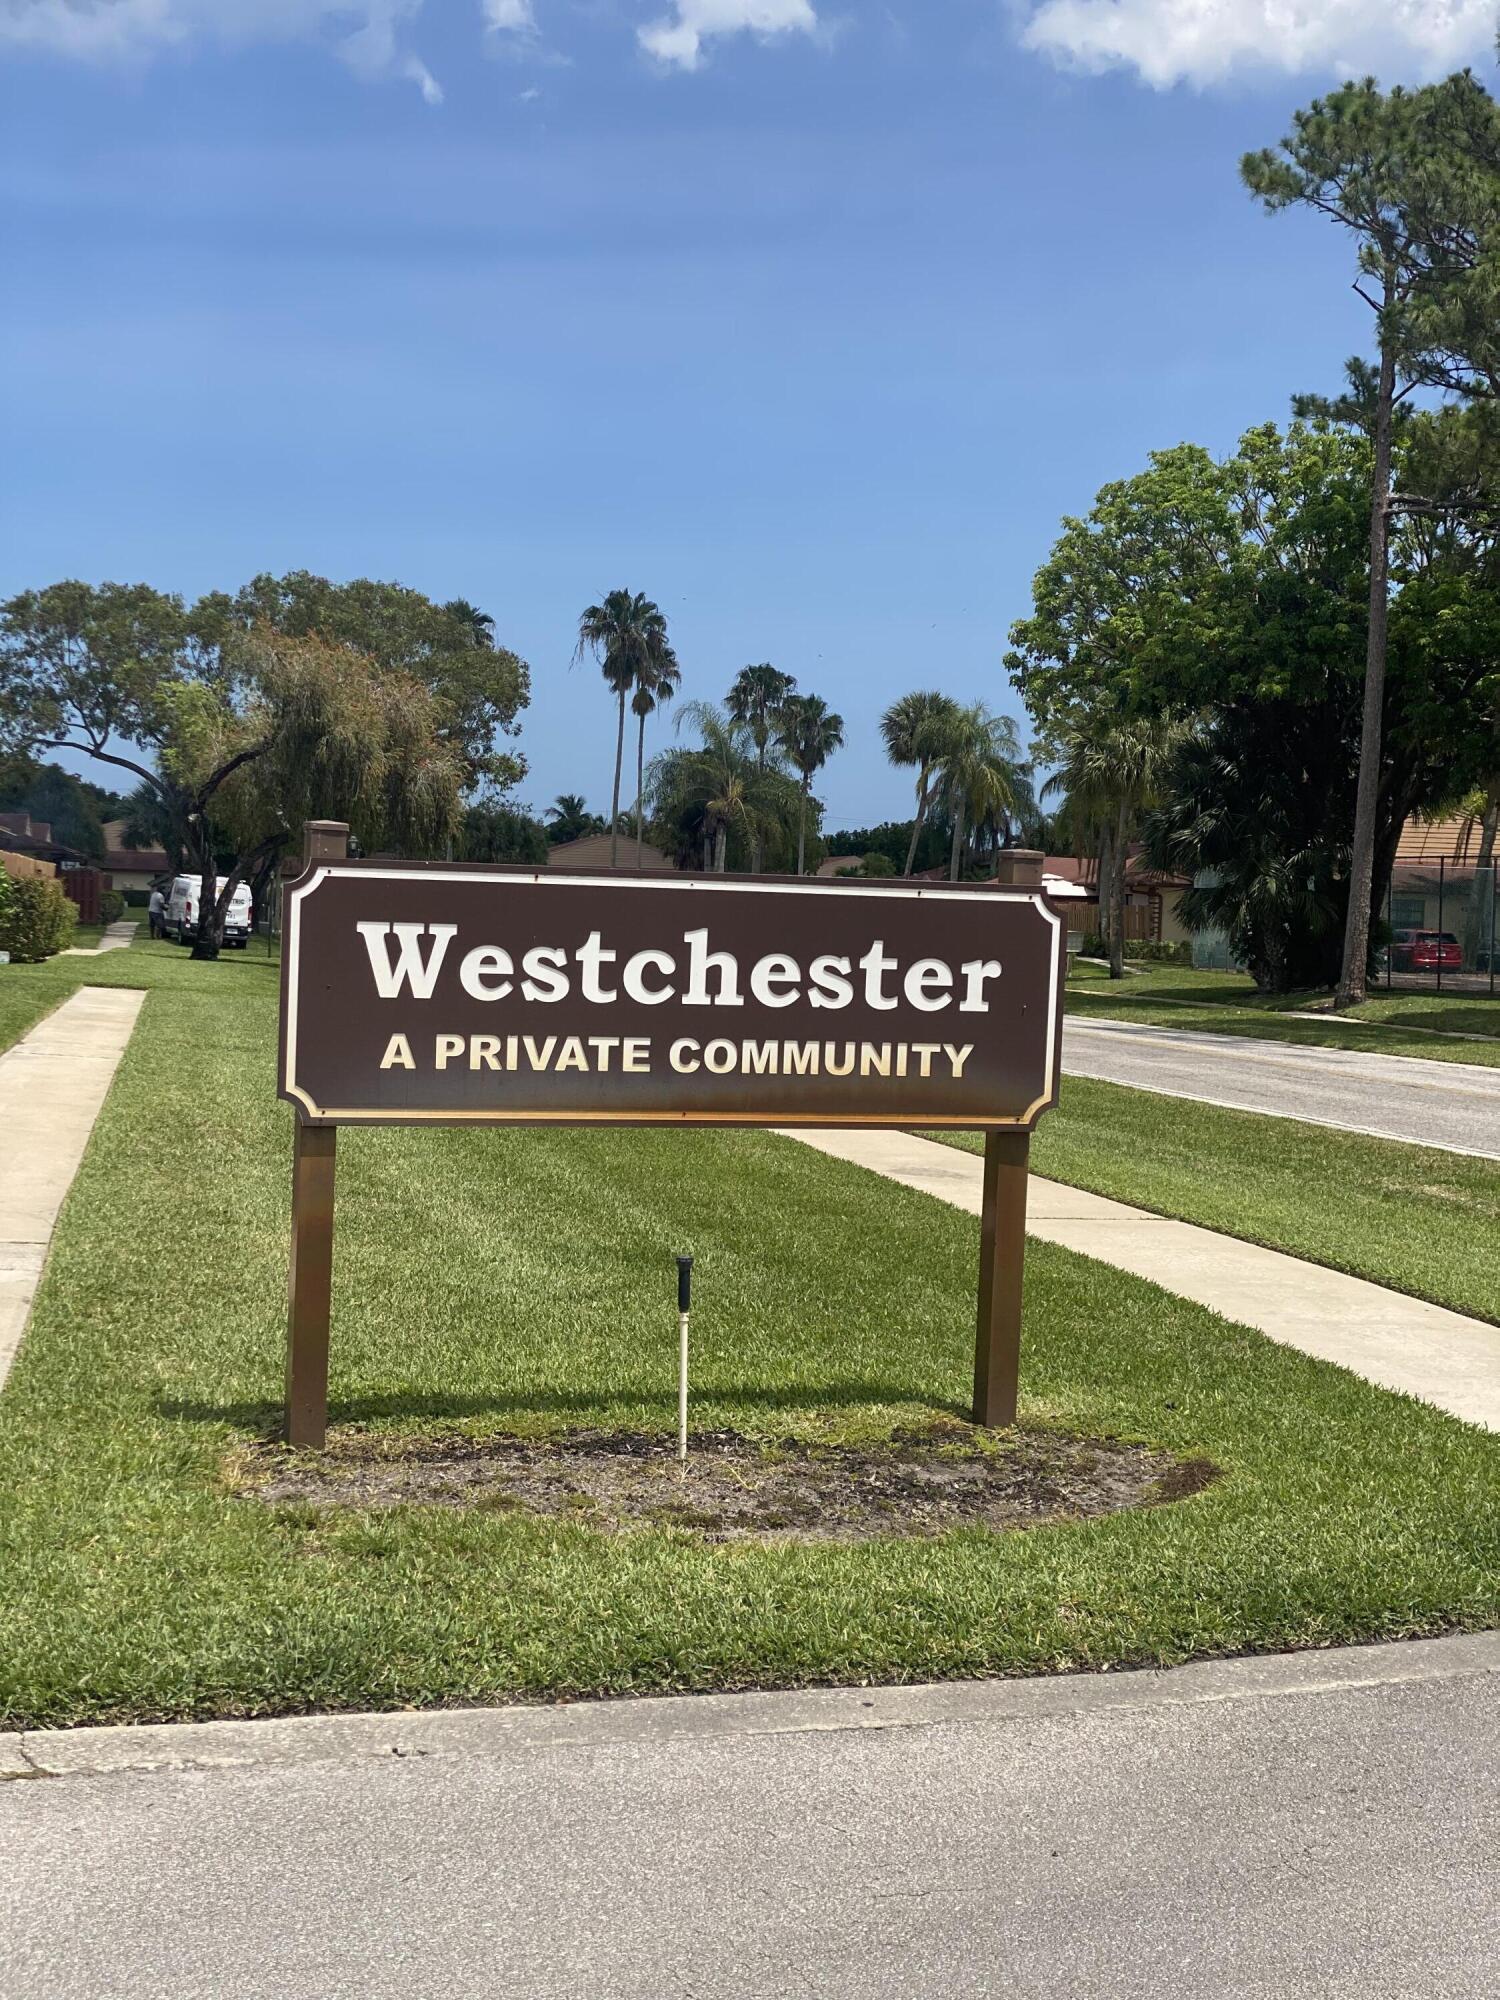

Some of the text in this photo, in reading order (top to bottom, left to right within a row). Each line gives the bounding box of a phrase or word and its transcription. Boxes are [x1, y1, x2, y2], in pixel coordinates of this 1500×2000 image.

[355, 920, 1003, 1013] Westchester
[379, 1033, 975, 1079] A PRIVATE COMMUNITY
